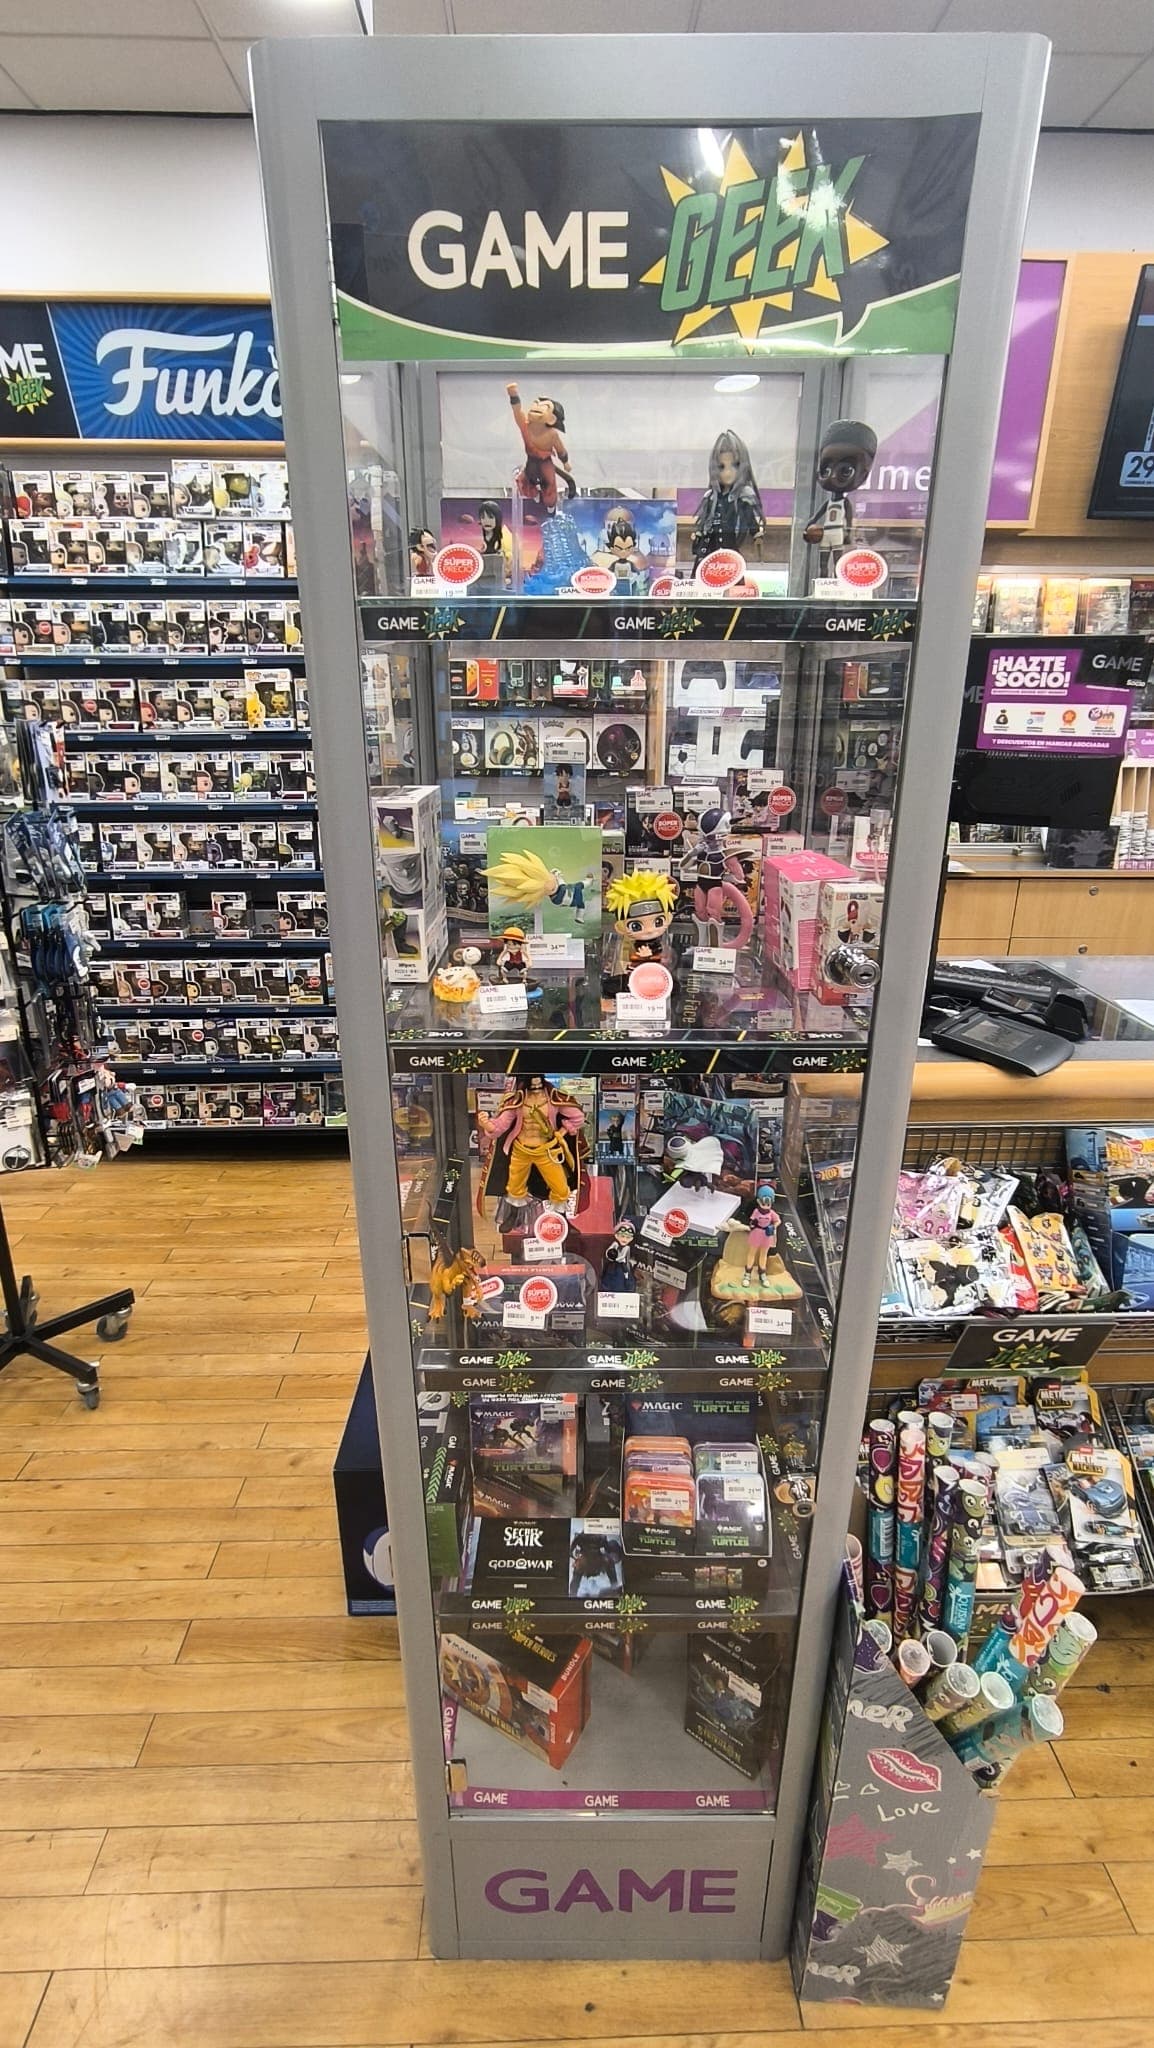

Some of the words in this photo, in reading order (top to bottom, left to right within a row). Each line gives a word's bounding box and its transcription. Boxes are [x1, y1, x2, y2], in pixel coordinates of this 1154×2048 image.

[407, 209, 629, 291] GAME
[659, 153, 868, 312] GEEK
[0, 343, 51, 380] ME
[9, 377, 45, 406] GEEK
[443, 556, 474, 566] SÚPER
[377, 617, 419, 631] GAME
[614, 617, 655, 630] GAME
[825, 618, 867, 631] GAME
[992, 656, 1067, 675] ¡HAZTE
[1092, 654, 1143, 671] GAME
[995, 672, 1071, 688] SOCIO!
[963, 686, 984, 703] ME
[997, 738, 1036, 746] DESCUENTOS
[409, 1056, 445, 1067] GAME
[611, 1057, 647, 1067] GAME
[792, 1056, 828, 1067] GAME
[527, 1287, 550, 1296] SÚPER
[993, 1328, 1082, 1343] GAME
[459, 1356, 494, 1365] GAME
[587, 1355, 622, 1364] GAME
[715, 1355, 750, 1364] GAME
[462, 1378, 497, 1387] GAME
[591, 1379, 625, 1388] GAME
[719, 1378, 754, 1387] GAME
[642, 1402, 684, 1410] MAGIC
[693, 1405, 750, 1413] TURTLES
[769, 1455, 781, 1475] GAME
[504, 1526, 540, 1541] SECRET
[506, 1534, 544, 1547] LAIR
[639, 1537, 676, 1546] TURTLES
[712, 1538, 750, 1547] TURTLES
[789, 1534, 802, 1560] GAME
[488, 1559, 515, 1570] GOD
[528, 1559, 553, 1571] WAR
[472, 1600, 502, 1609] GAME
[584, 1600, 614, 1609] GAME
[696, 1600, 726, 1609] GAME
[974, 1603, 1008, 1616] ME
[473, 1622, 503, 1630] GAME
[585, 1622, 615, 1630] GAME
[560, 1654, 581, 1681] BUNDLE
[444, 1706, 454, 1740] GAME
[473, 1791, 508, 1805] GAME
[584, 1795, 619, 1807] GAME
[696, 1795, 731, 1807] GAME
[876, 1798, 941, 1823] Love
[484, 1868, 738, 1914] GAME
